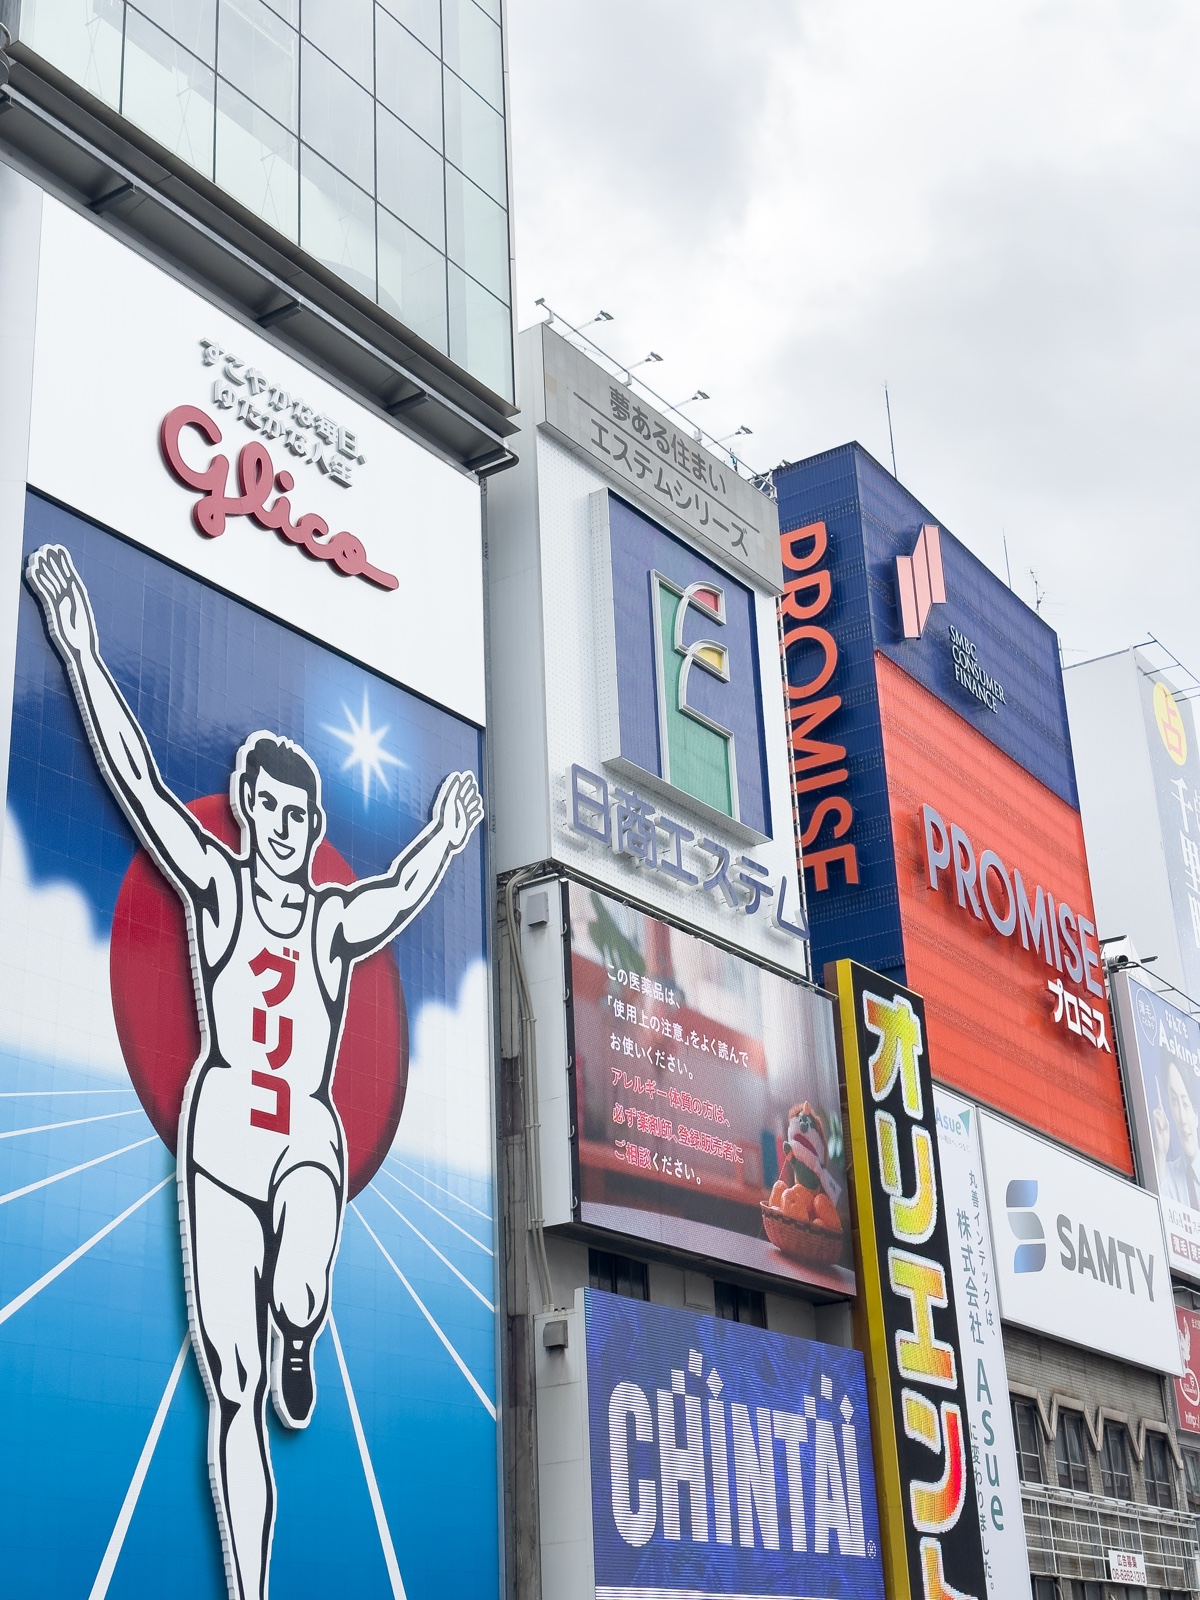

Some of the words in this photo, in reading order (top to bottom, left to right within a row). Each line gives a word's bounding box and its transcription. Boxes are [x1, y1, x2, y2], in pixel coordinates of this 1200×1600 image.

[199, 337, 367, 466] すこやかな毎日、
[211, 379, 353, 489] ゆたかな人生
[608, 385, 727, 495] 夢ある住まい
[158, 404, 399, 592] Glico
[590, 418, 749, 557] エステムシリーズ
[949, 624, 978, 662] SMBC
[952, 645, 1006, 705] CONSUMER
[954, 663, 998, 714] FINANCE
[777, 521, 859, 892] PROMISE
[566, 763, 811, 940] 日商エステム
[919, 803, 1104, 1000] PROMISE
[248, 946, 300, 1136] グリコ
[607, 963, 681, 1009] この医薬品は、
[607, 994, 749, 1068] 「使用上の注意」をよく読んで
[1046, 978, 1112, 1054] プロミス
[610, 1032, 694, 1080] お使いください。
[611, 1067, 731, 1128] アレルギー体質の方は、
[614, 1139, 702, 1184] ご相談ください。
[935, 1106, 962, 1136] Asue
[968, 1170, 996, 1336] 丸善インテックは、
[1056, 1213, 1154, 1303] SAMTY
[956, 1208, 985, 1345] 株式会社
[976, 1358, 1005, 1532] Asue
[608, 1366, 867, 1557] CHINTAI
[969, 1421, 995, 1591] に変わりました。
